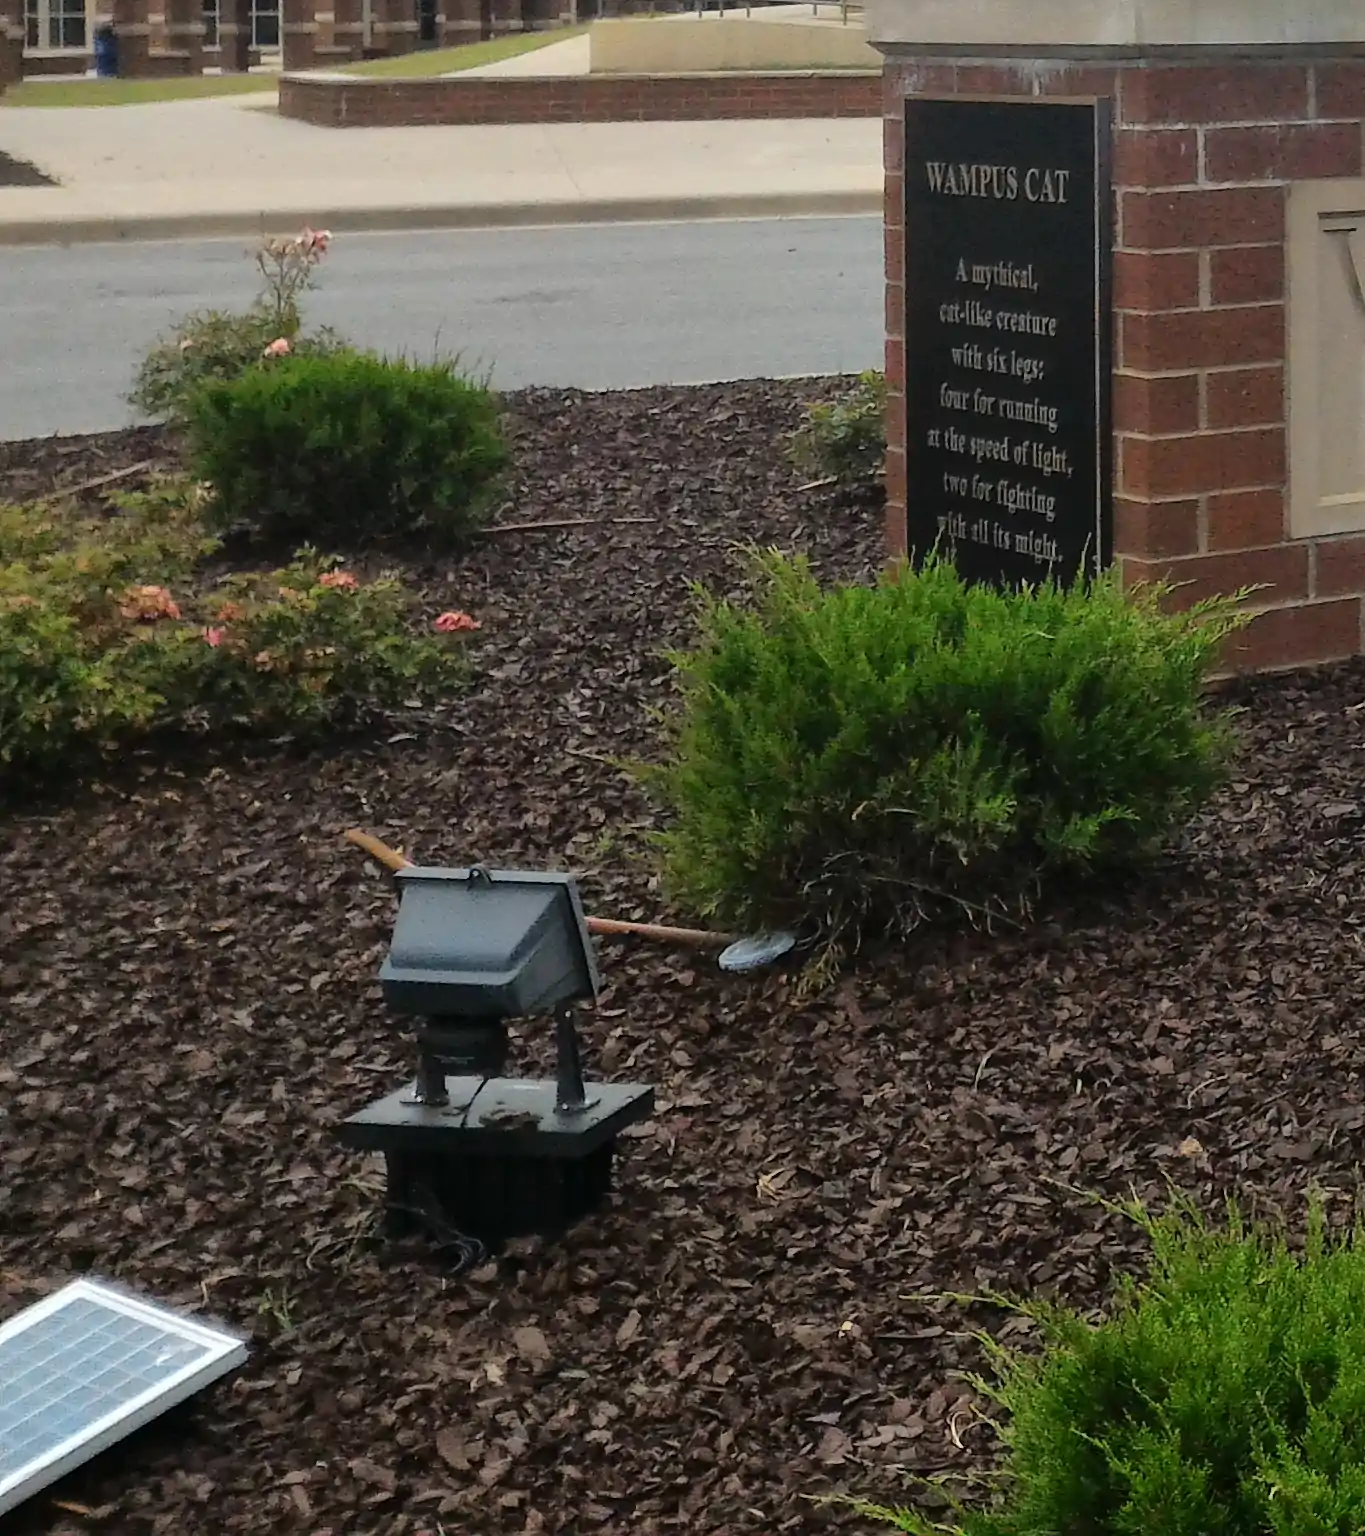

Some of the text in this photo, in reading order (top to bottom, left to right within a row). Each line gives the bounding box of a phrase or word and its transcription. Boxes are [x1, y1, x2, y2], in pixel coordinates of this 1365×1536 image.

[926, 162, 1070, 204] WAMPUS CAT
[955, 256, 1038, 293] A mythical,
[939, 299, 1057, 336] cat-like creature
[951, 342, 983, 370] with
[986, 347, 1008, 373] six
[940, 382, 1059, 434] four for running
[927, 426, 1073, 479] at the speed of light,
[943, 471, 1056, 523] two for fighting
[971, 518, 989, 544] all
[993, 522, 1010, 550] its
[1015, 530, 1063, 564] might.
